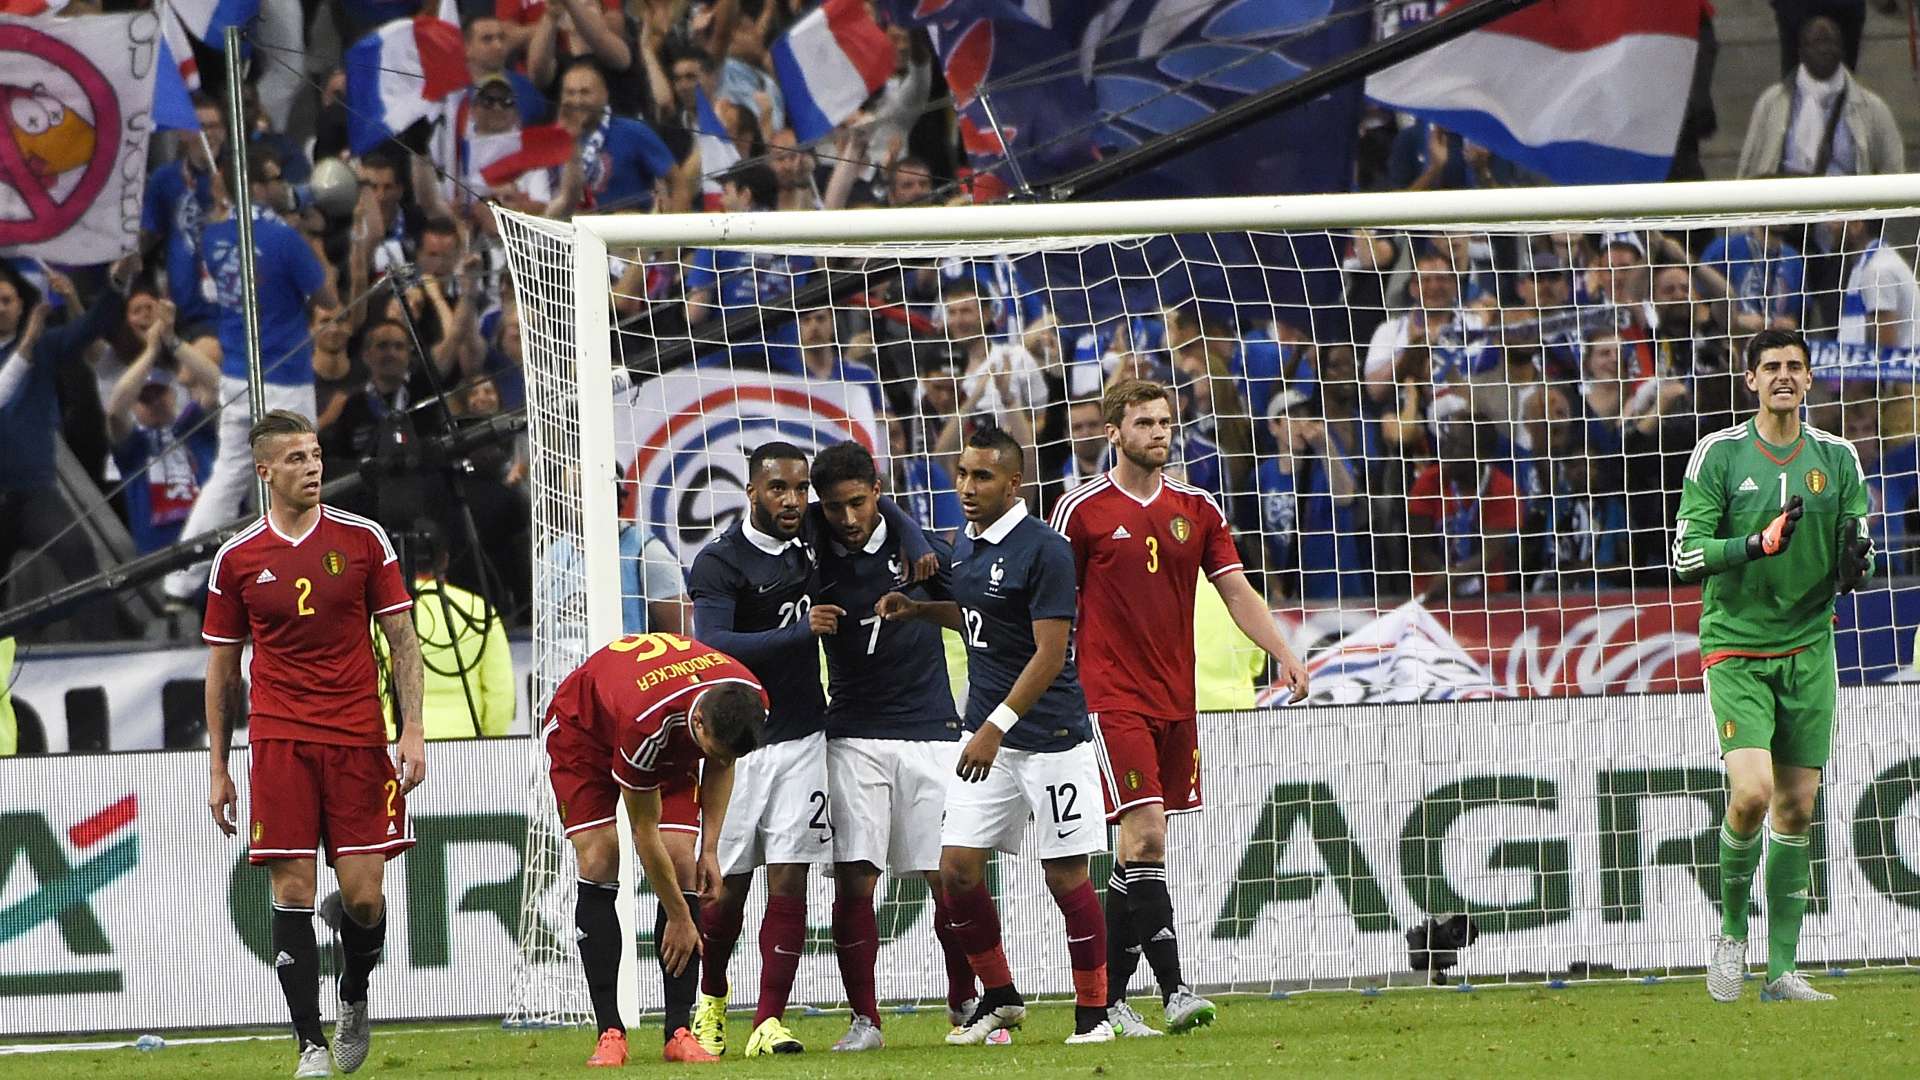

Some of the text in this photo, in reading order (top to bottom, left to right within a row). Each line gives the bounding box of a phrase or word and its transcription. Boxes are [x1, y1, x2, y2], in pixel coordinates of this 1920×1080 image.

[1778, 472, 1787, 508] 1
[1145, 536, 1159, 574] 3
[295, 577, 315, 616] 2
[859, 614, 882, 655] 7
[961, 606, 988, 649] 12
[384, 779, 398, 817] 2
[809, 790, 835, 829] 2
[1046, 782, 1082, 823] 12
